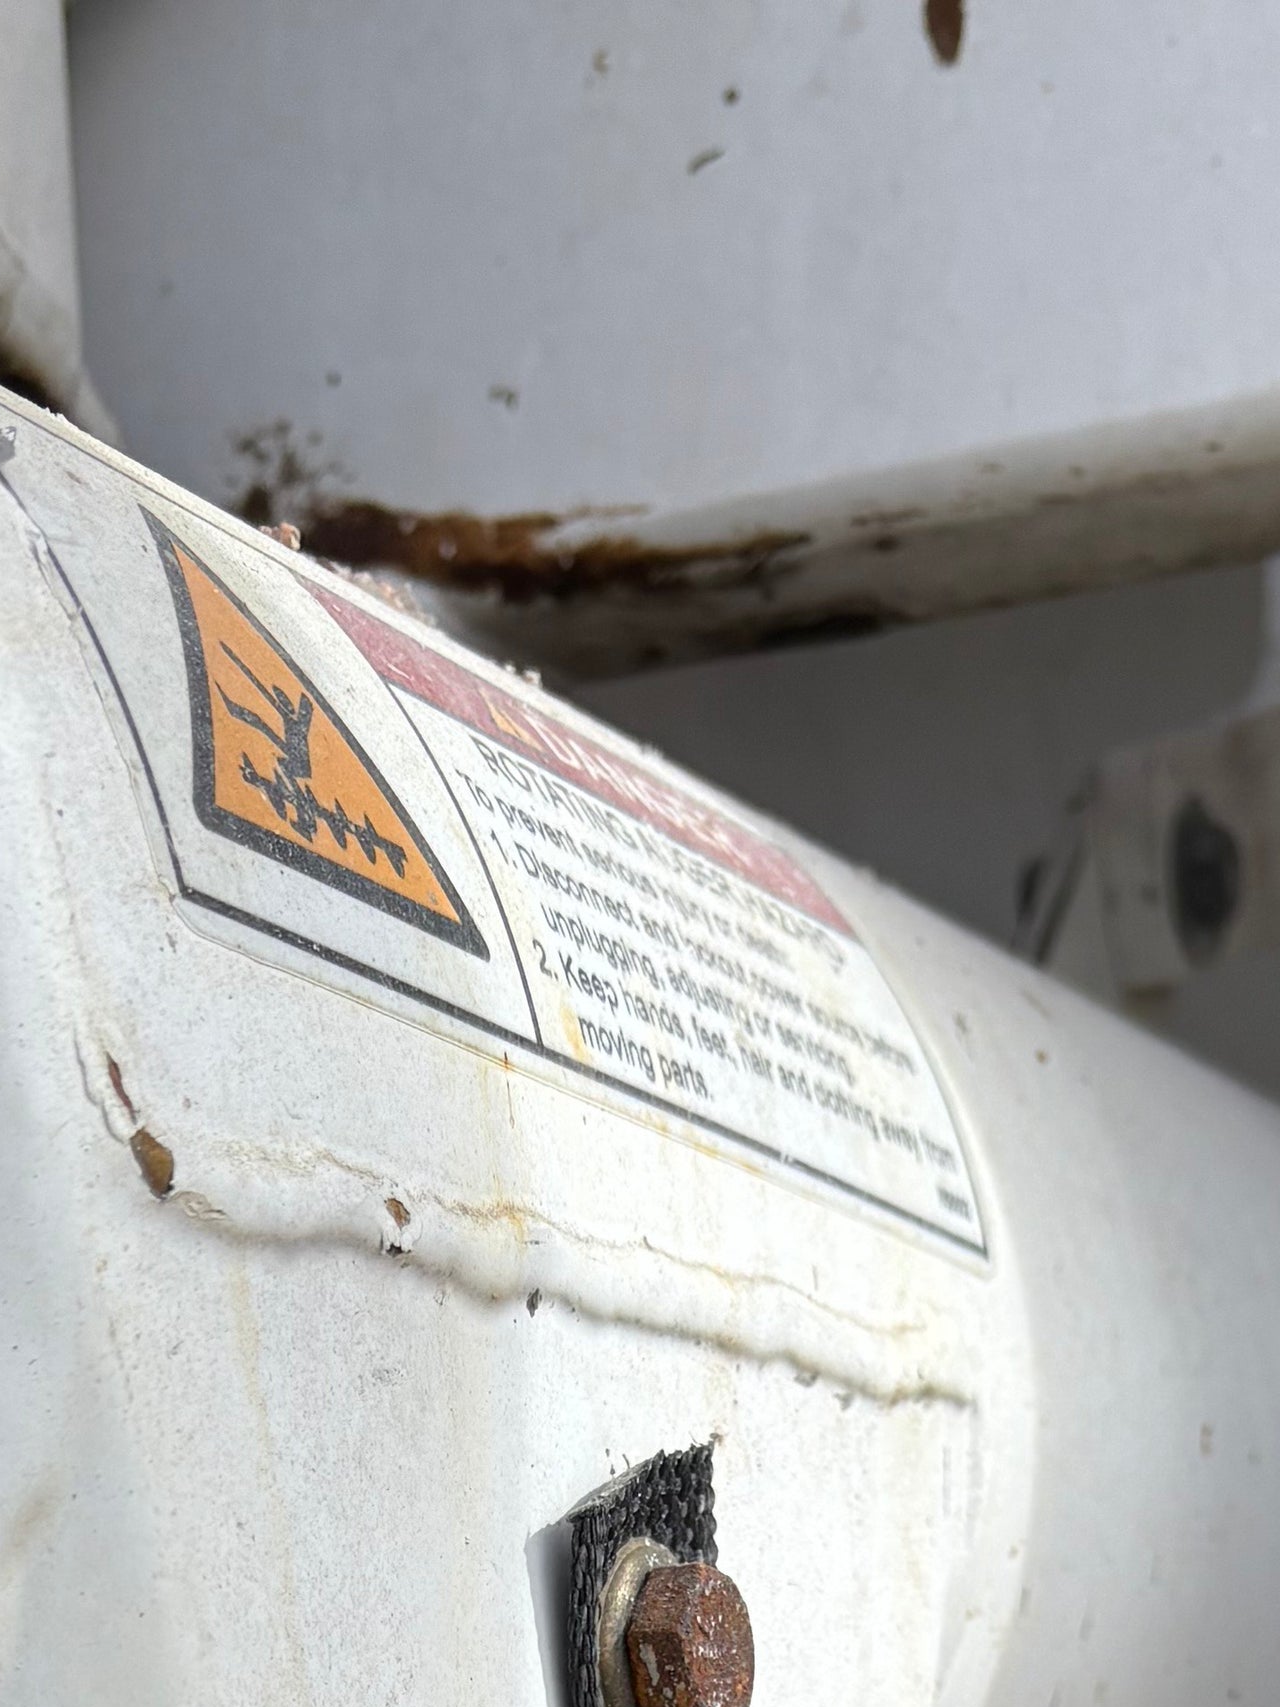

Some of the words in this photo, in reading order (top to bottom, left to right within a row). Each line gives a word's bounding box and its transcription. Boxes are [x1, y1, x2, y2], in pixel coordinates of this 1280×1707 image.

[455, 768, 494, 814] To
[494, 795, 583, 861] prevent
[581, 842, 659, 900] serious
[468, 734, 639, 850] ROTATING
[490, 829, 518, 869] 1.
[513, 840, 640, 932] Disconnect
[639, 911, 681, 953] and
[540, 902, 666, 991] unplugging,
[665, 963, 754, 1036] adjusting
[532, 937, 558, 981] 2.
[558, 950, 618, 1014] Keep
[618, 979, 692, 1048] hands,
[734, 1038, 774, 1084] hair
[777, 1064, 812, 1103] and
[813, 1078, 880, 1142] clothing
[879, 1115, 922, 1162] away
[577, 1016, 656, 1083] moving
[657, 1052, 713, 1101] parts.
